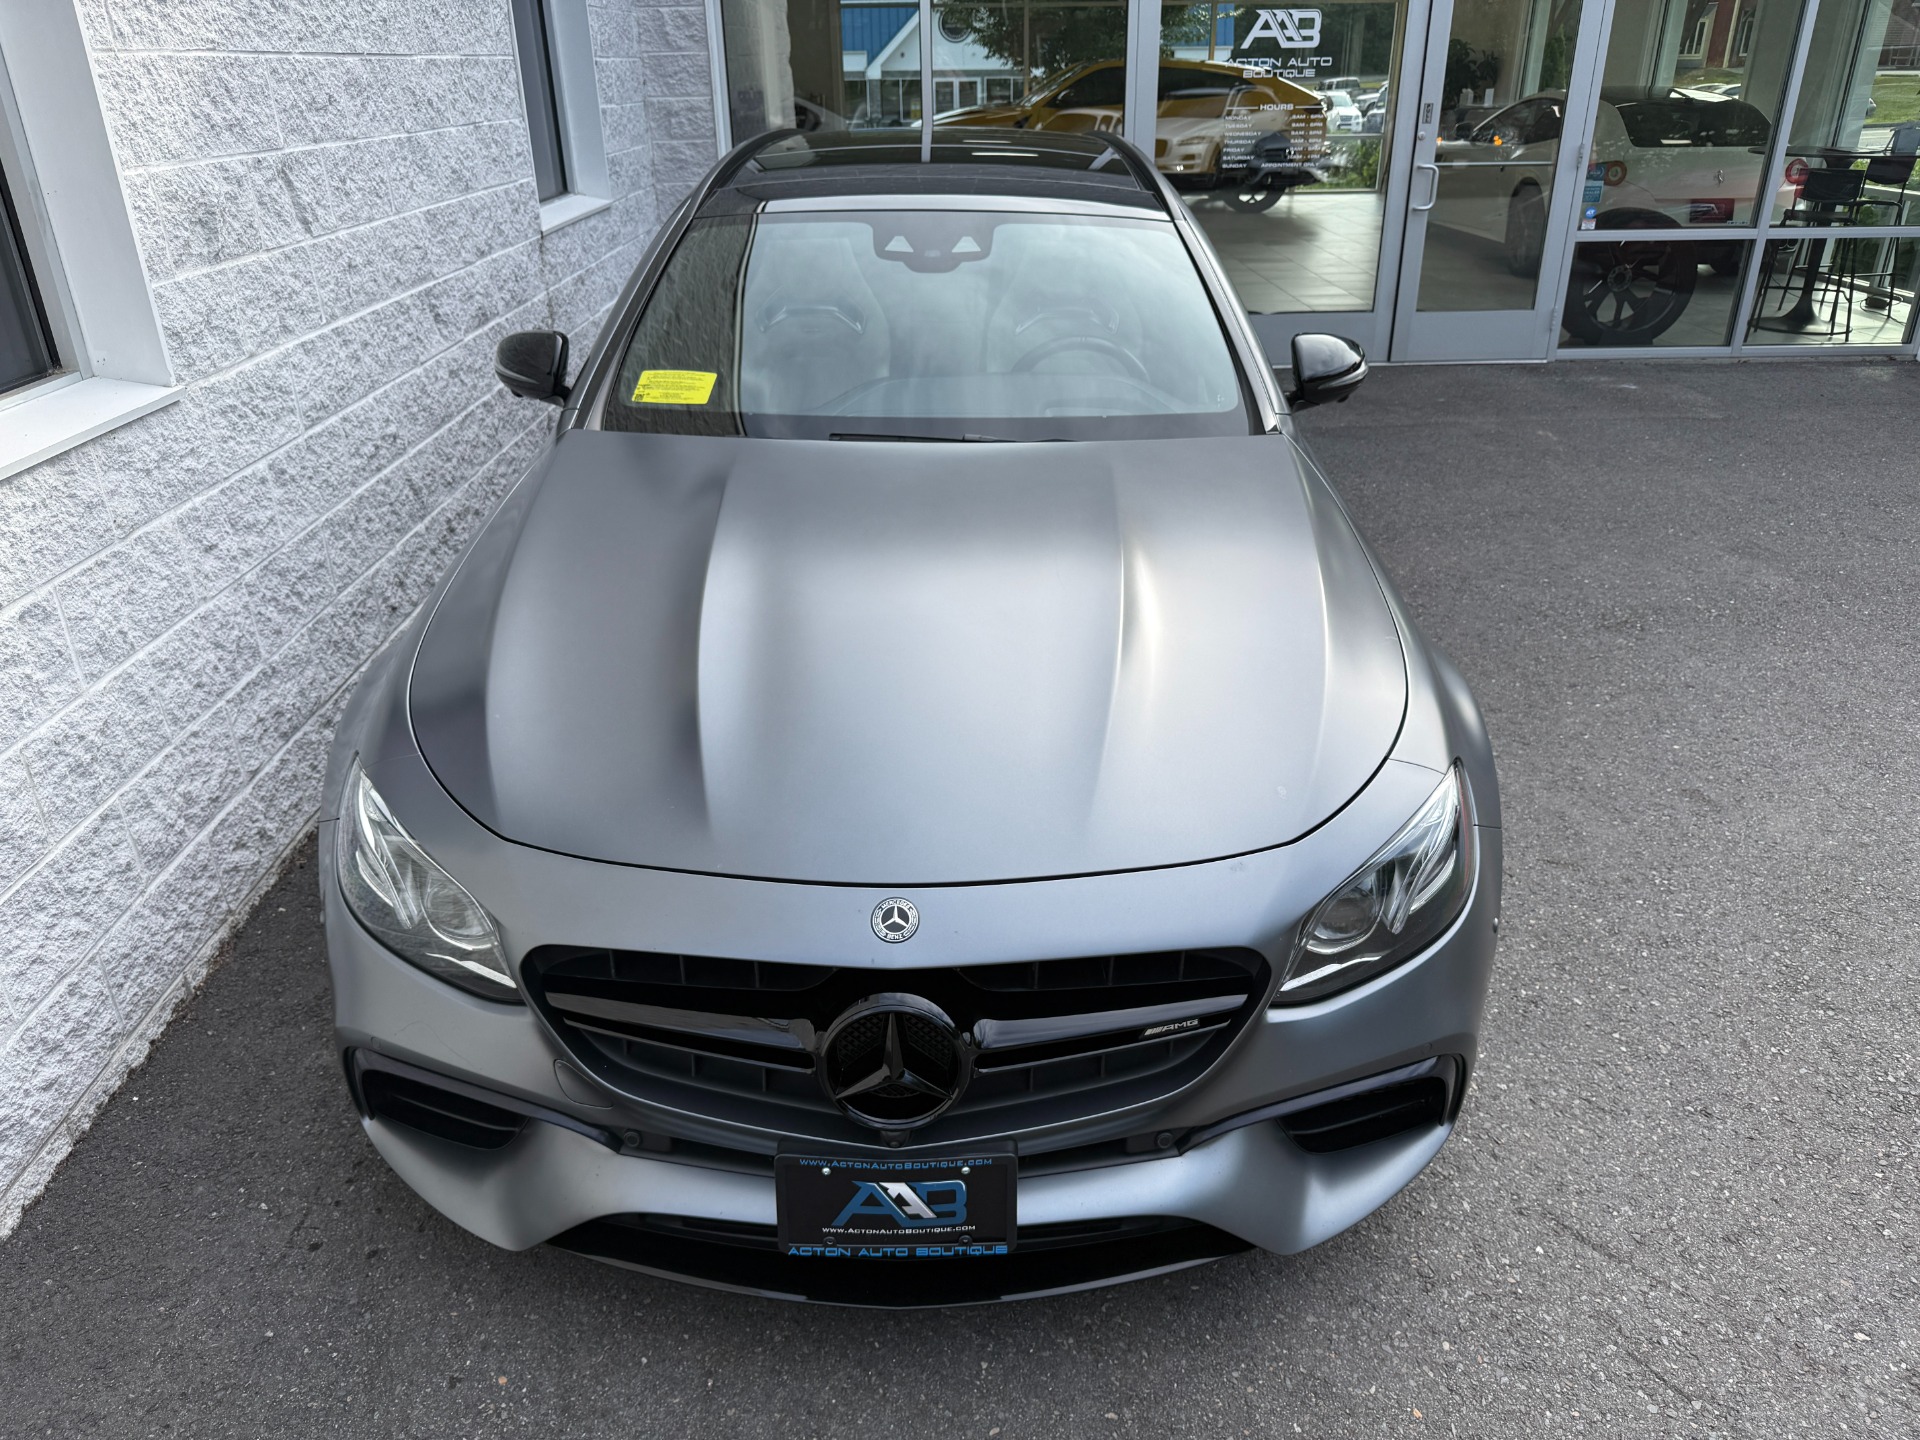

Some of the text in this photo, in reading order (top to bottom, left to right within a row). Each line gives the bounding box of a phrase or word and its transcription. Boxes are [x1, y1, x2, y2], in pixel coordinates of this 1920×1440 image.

[1240, 9, 1322, 49] AAB
[1226, 56, 1333, 67] ACTON AUTO
[1242, 69, 1316, 79] BOUTIQUE
[1260, 103, 1294, 111] HOURS
[1161, 1018, 1199, 1032] AMG
[831, 1180, 967, 1228] AAB
[788, 1245, 1009, 1257] ACTON AUTO BOUTIQUE
